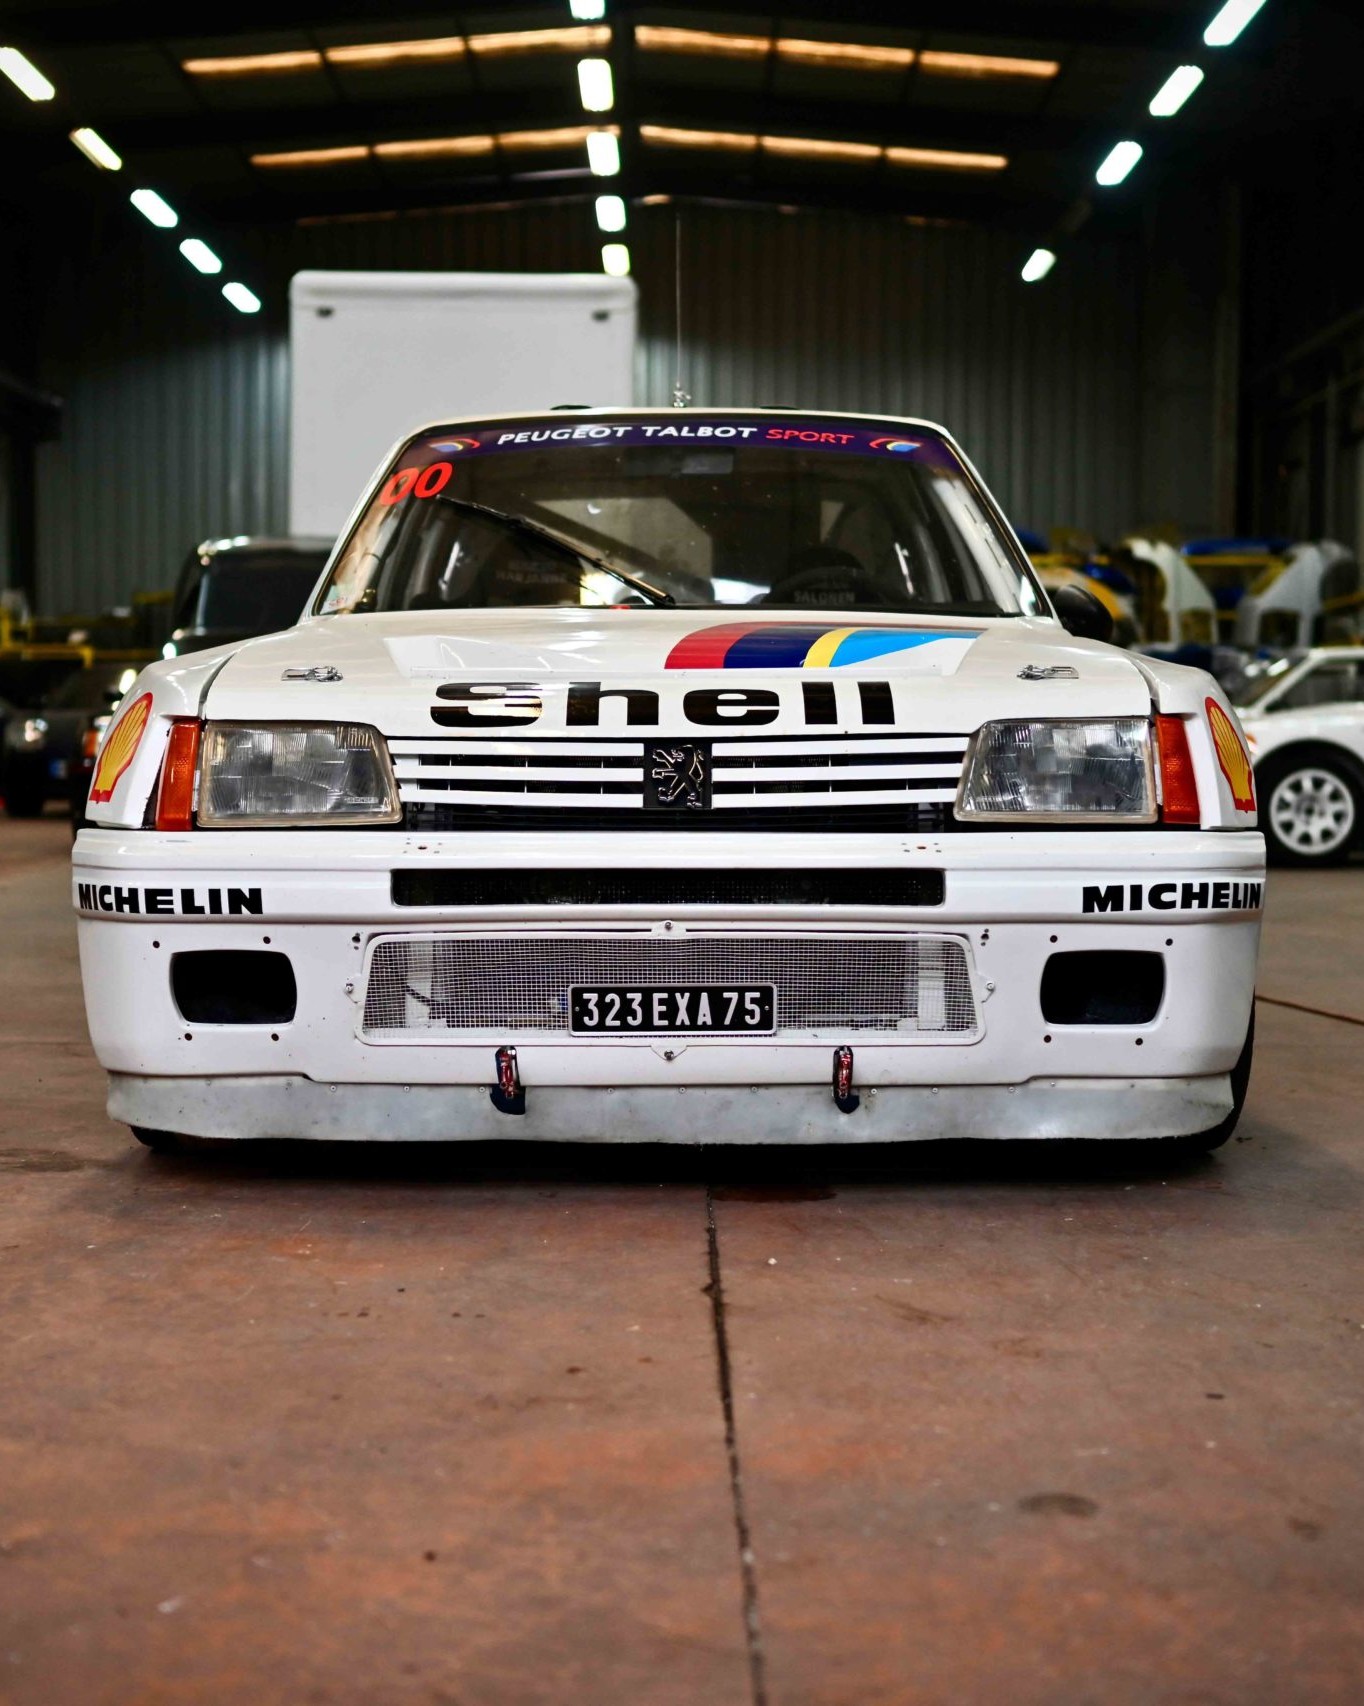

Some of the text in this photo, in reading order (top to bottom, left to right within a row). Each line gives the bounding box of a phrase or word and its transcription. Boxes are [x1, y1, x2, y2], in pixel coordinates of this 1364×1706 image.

[497, 426, 855, 445] PEUGEOT TALBOT SPORT
[379, 462, 453, 507] 00
[430, 681, 896, 728] Shell
[78, 883, 263, 915] MICHELIN
[1082, 882, 1262, 914] MICHELIN
[722, 991, 761, 1026] 75
